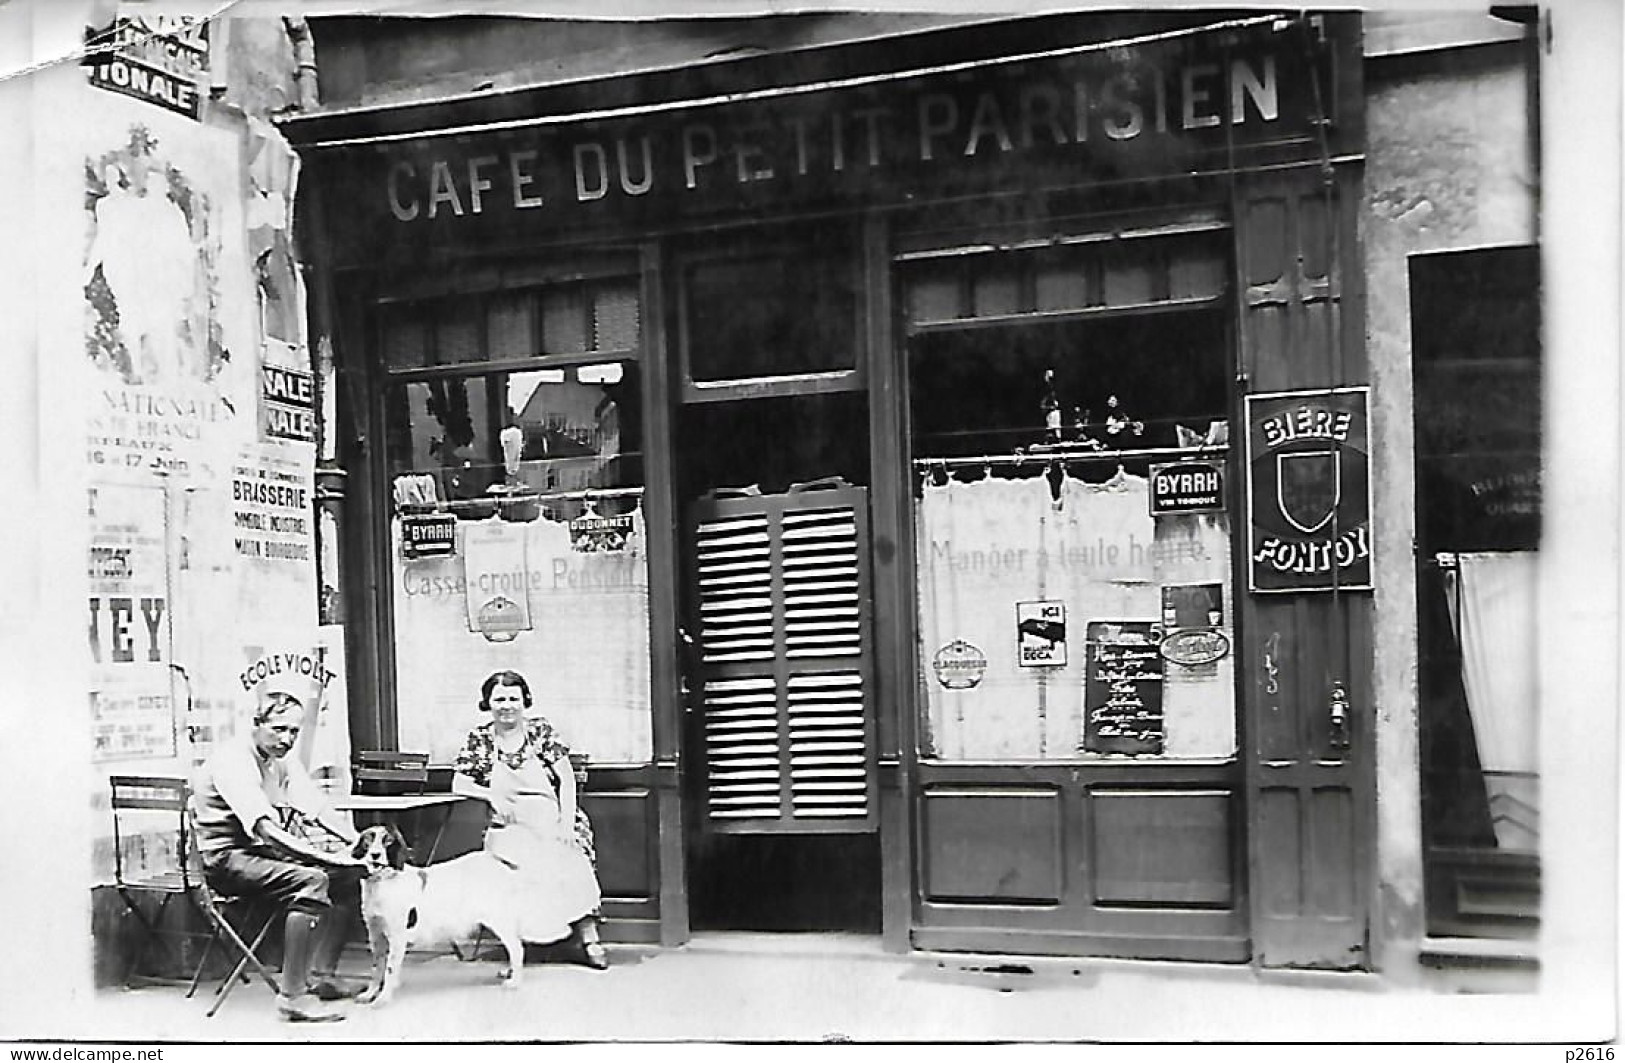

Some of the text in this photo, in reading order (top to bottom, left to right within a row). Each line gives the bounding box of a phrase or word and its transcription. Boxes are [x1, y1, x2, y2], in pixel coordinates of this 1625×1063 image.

[573, 137, 653, 201] DU
[683, 108, 890, 188] PETIT
[917, 56, 1280, 161] PARISIEN
[232, 480, 307, 509] BRASSERIE
[1157, 472, 1218, 494] BYRRH
[412, 524, 453, 541] BYRRH
[1254, 528, 1369, 573] FONTOY
[240, 655, 281, 691] ECOLE
